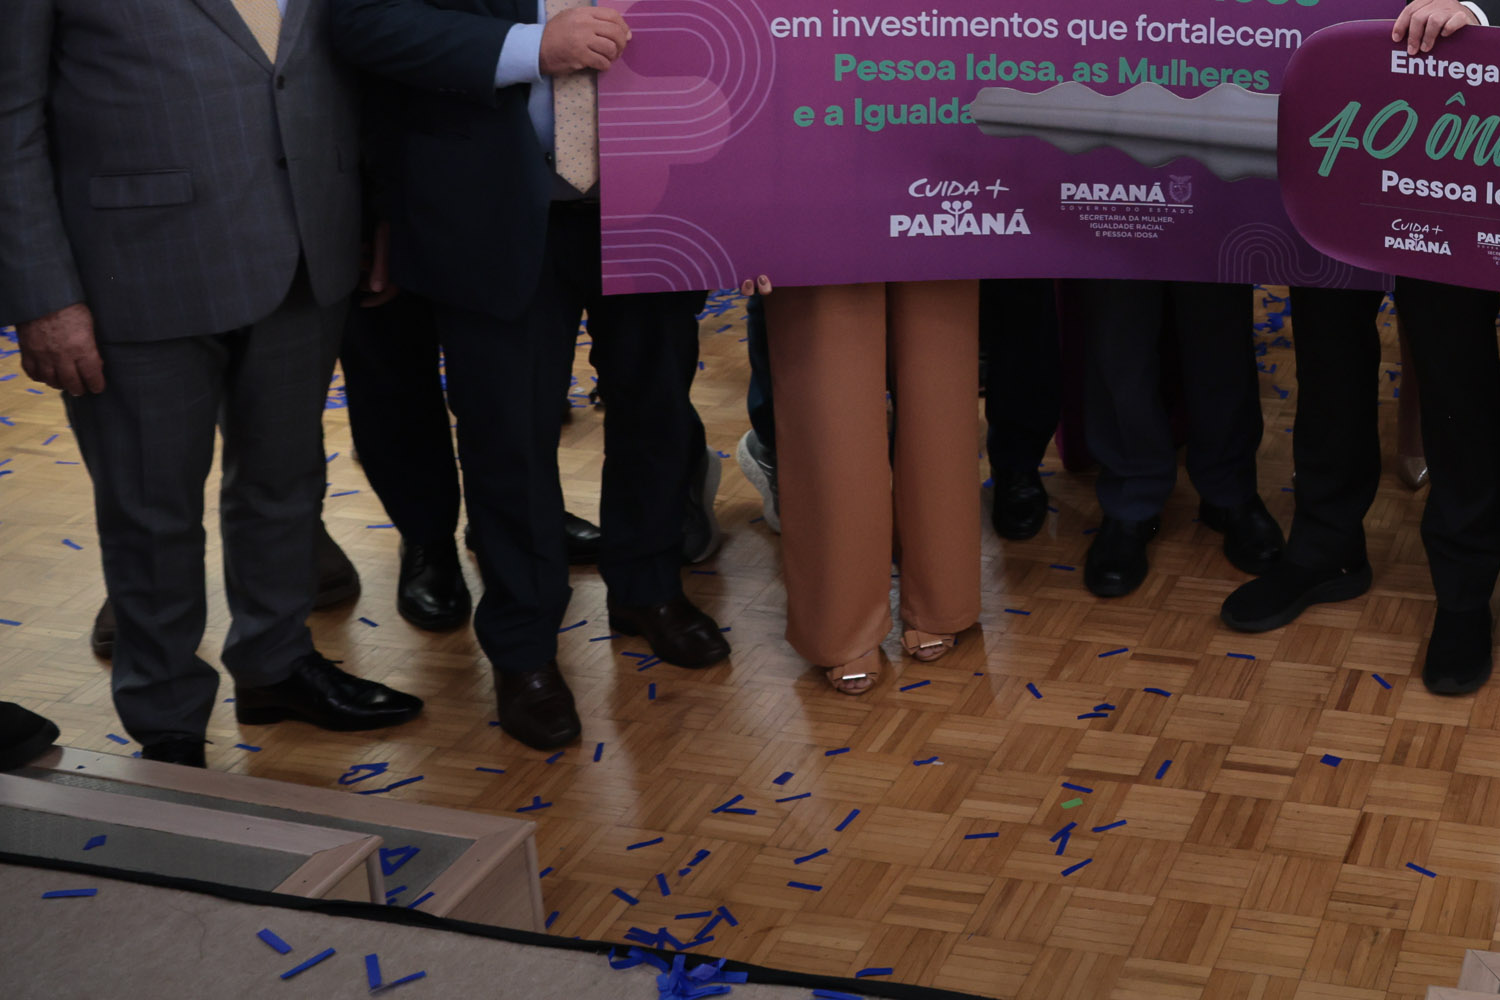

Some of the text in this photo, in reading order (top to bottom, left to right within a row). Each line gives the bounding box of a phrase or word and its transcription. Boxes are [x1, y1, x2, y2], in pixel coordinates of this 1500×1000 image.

[770, 9, 1302, 49] em investimentos que fortalecem
[833, 53, 1270, 91] Pessoa Idosa, as Mulheres
[1390, 50, 1500, 87] Entrega
[793, 97, 975, 132] e a Igualda
[1309, 98, 1418, 177] 40
[908, 177, 1010, 199] CUIDA +
[1060, 181, 1166, 203] PARANÁ
[1381, 170, 1478, 203] Pessoa
[889, 208, 1032, 238] PARANÁ
[1080, 214, 1127, 222] SECRETARIA
[1141, 216, 1175, 224] MULHER,
[1149, 207, 1194, 215] ESTADO
[1089, 222, 1164, 231] IGUALDADE RACIAL
[1431, 224, 1444, 235] +
[1384, 236, 1452, 256] PARANÁ
